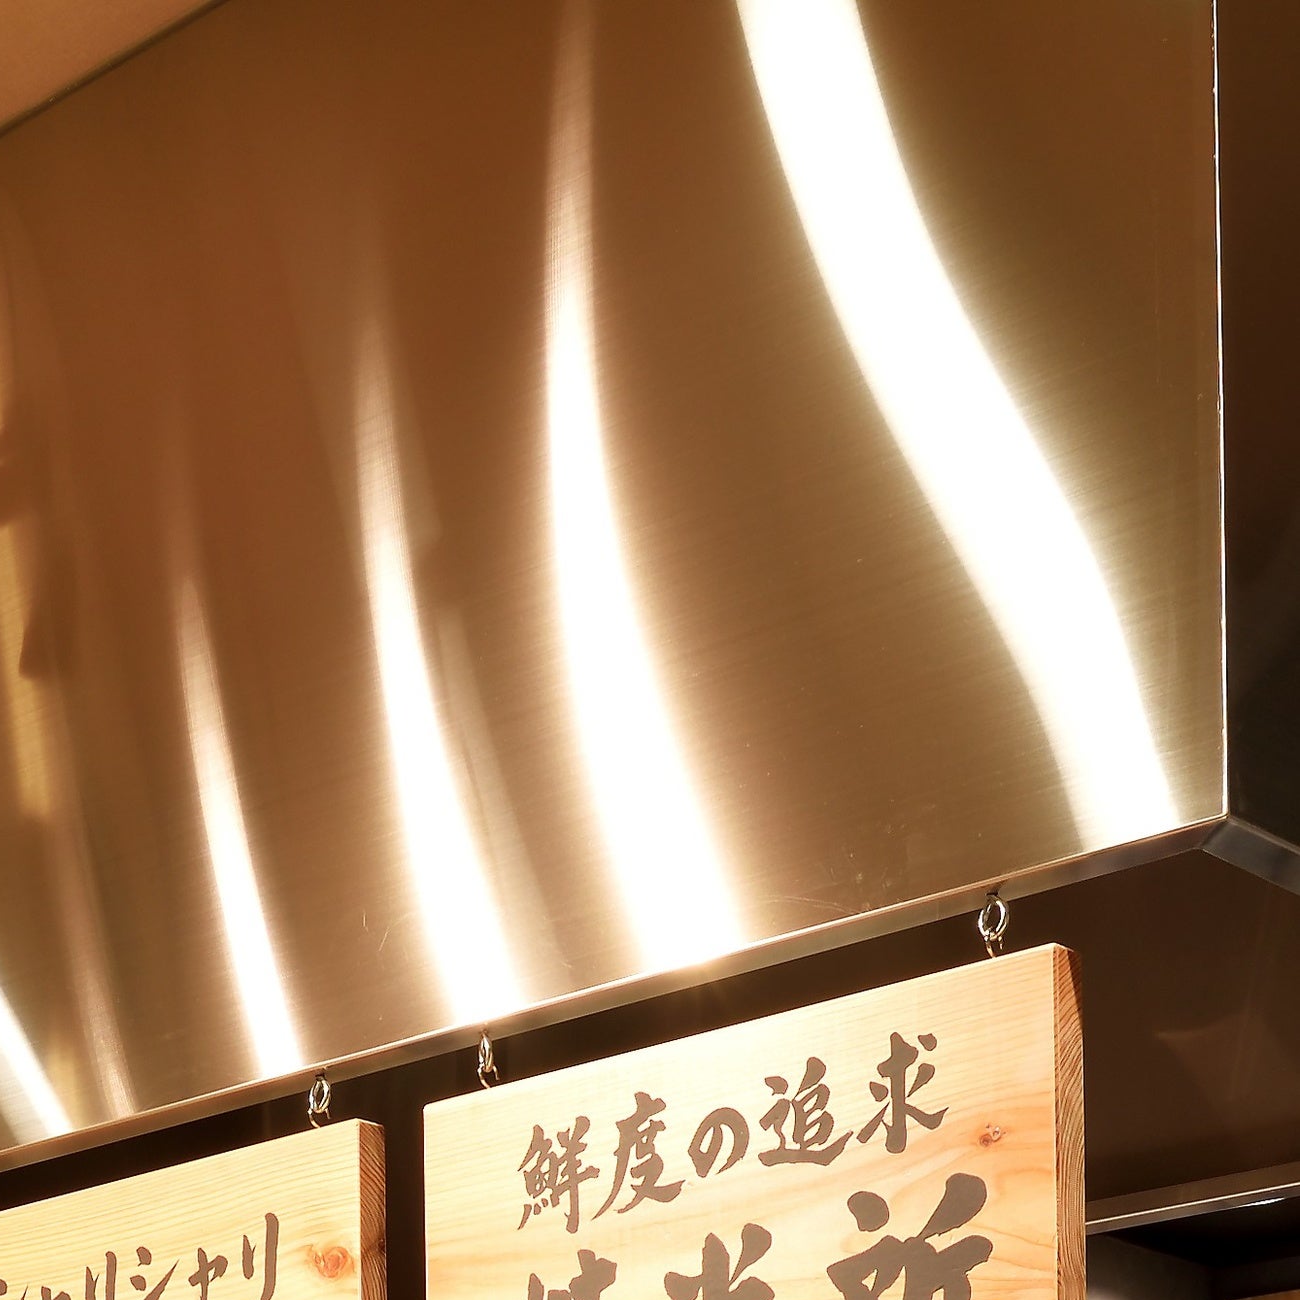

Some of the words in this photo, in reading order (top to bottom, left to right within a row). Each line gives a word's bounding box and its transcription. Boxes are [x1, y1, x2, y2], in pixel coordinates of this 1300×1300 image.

[517, 1032, 949, 1235] 鮮度の追求
